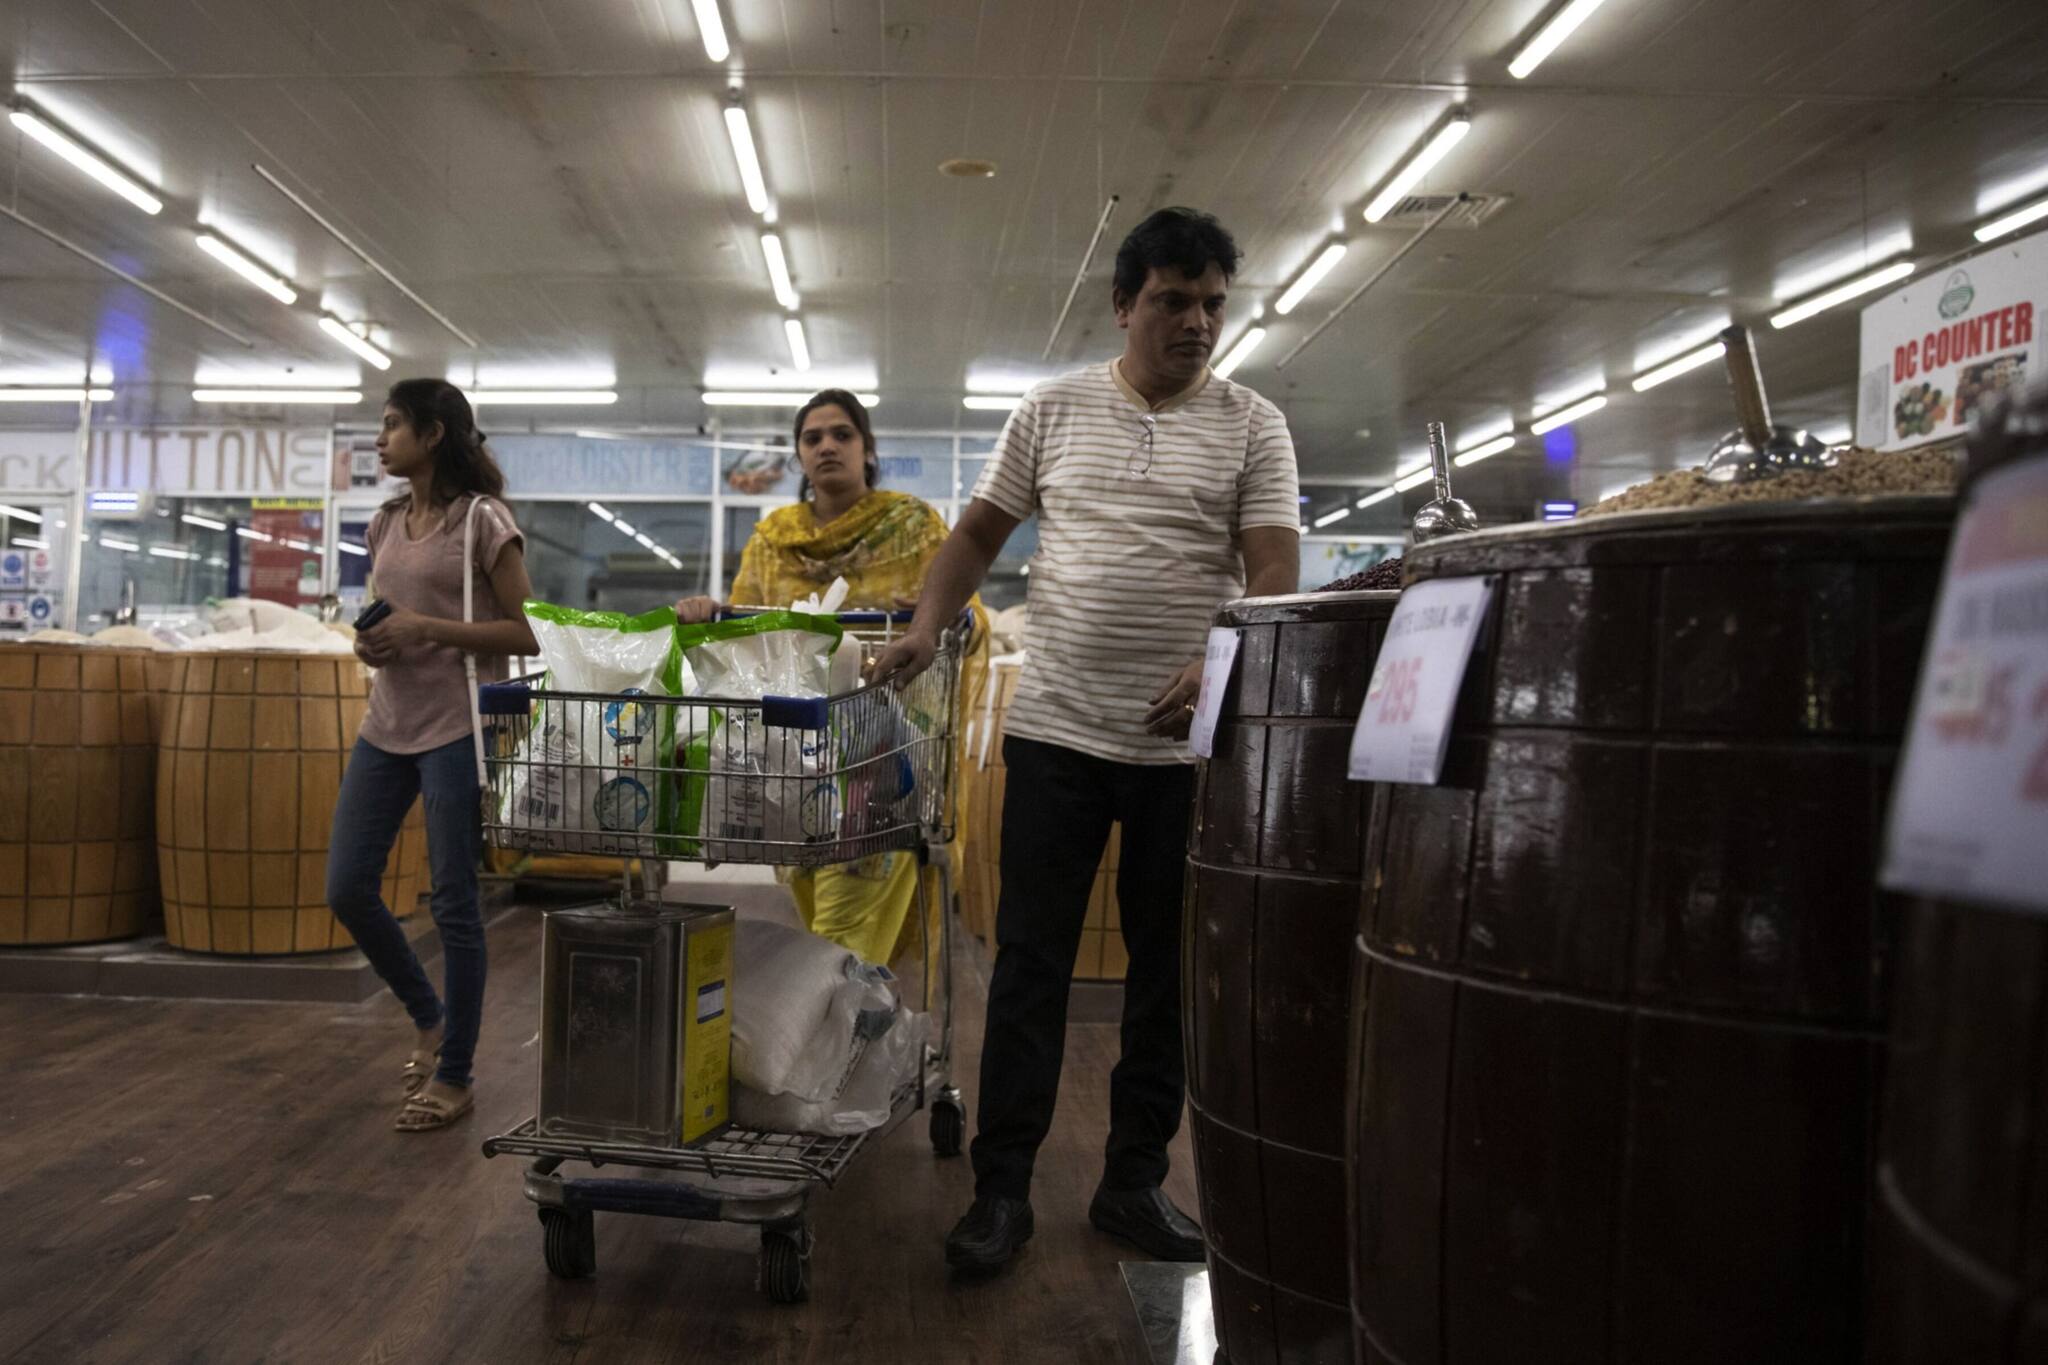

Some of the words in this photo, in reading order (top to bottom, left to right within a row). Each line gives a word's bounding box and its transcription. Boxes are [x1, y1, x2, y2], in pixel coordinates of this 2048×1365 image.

[1894, 339, 1918, 384] DC
[1921, 301, 2034, 373] COUNTER
[86, 430, 287, 491] UTTON
